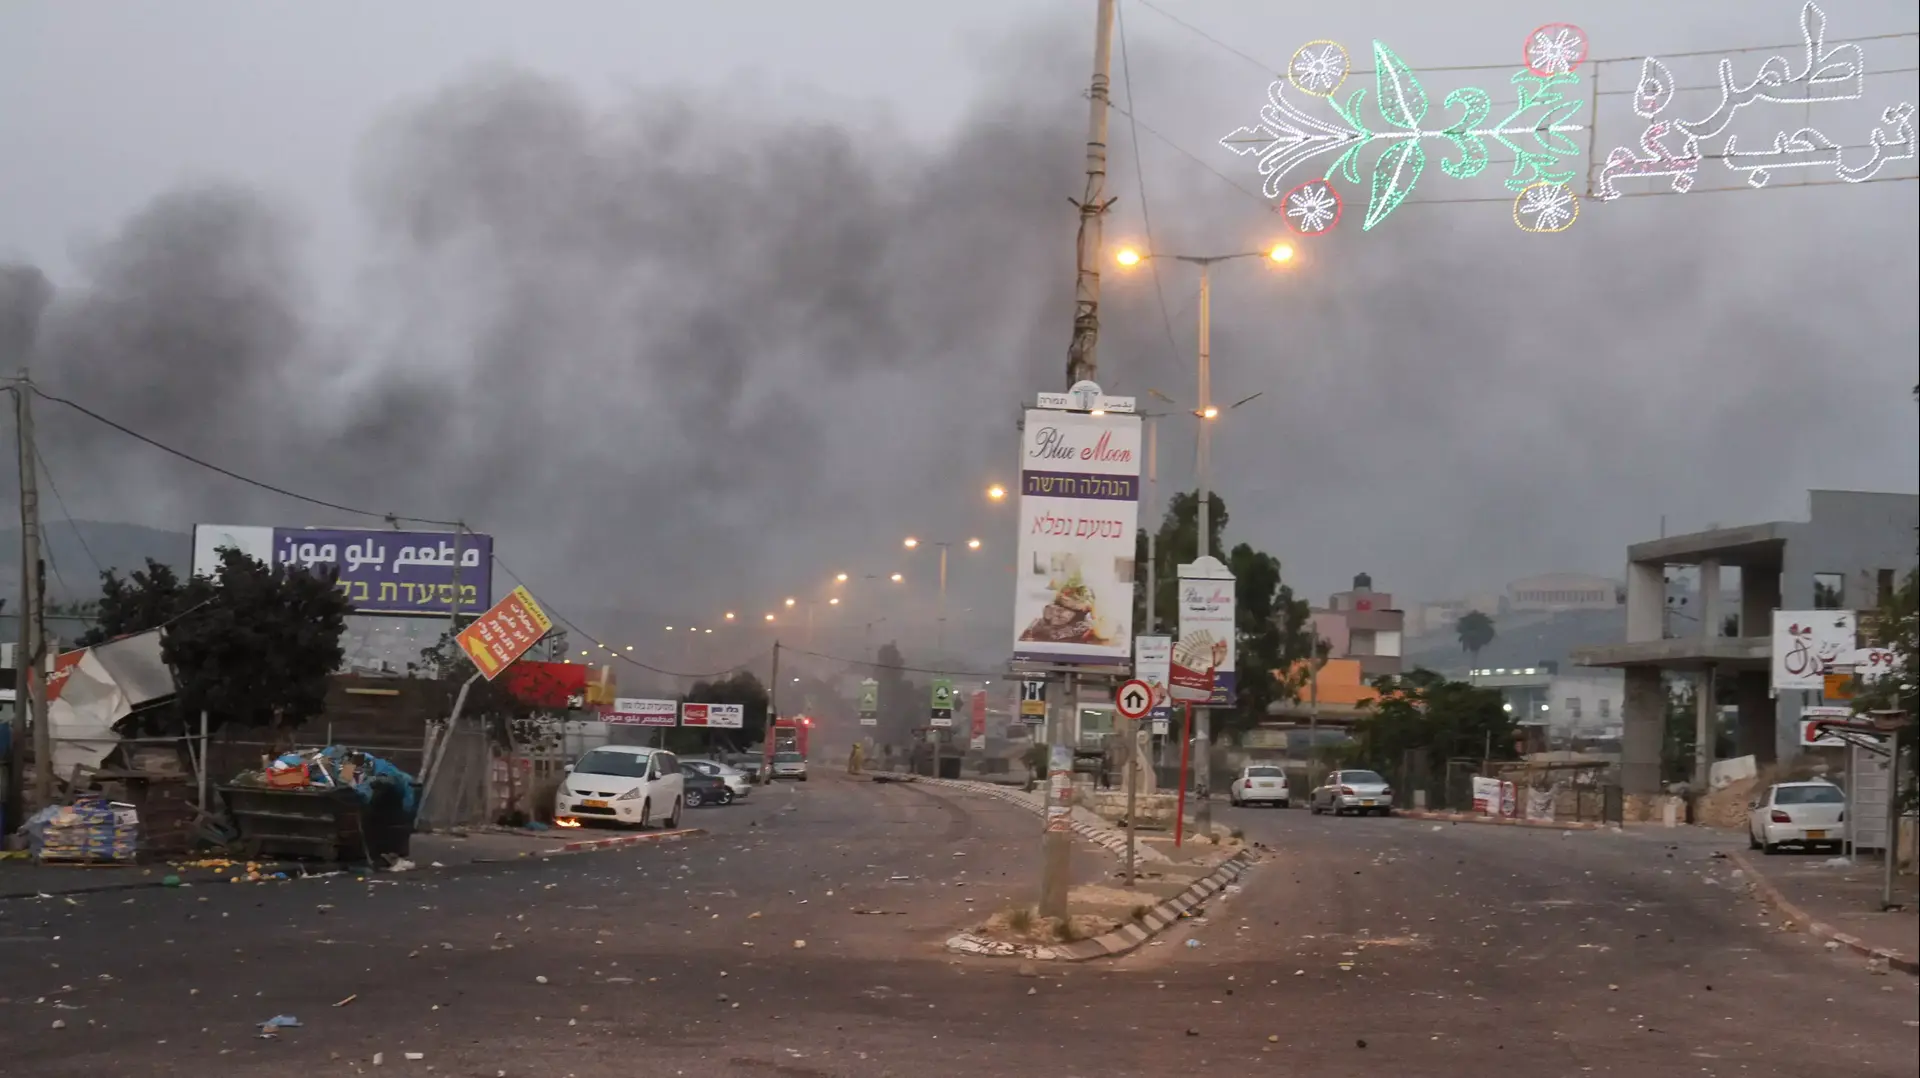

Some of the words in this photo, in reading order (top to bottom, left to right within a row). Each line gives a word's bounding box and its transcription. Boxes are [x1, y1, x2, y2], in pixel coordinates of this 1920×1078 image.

[1029, 426, 1077, 460] Blue
[1080, 429, 1133, 462] Moon
[1029, 476, 1076, 494] חדשה
[1080, 475, 1131, 497] הנהלה
[1031, 510, 1073, 536] נפלא
[1076, 518, 1123, 540] בטעם
[345, 538, 386, 572] بلو
[393, 541, 479, 574] مطعم
[380, 581, 476, 605] מסעדת
